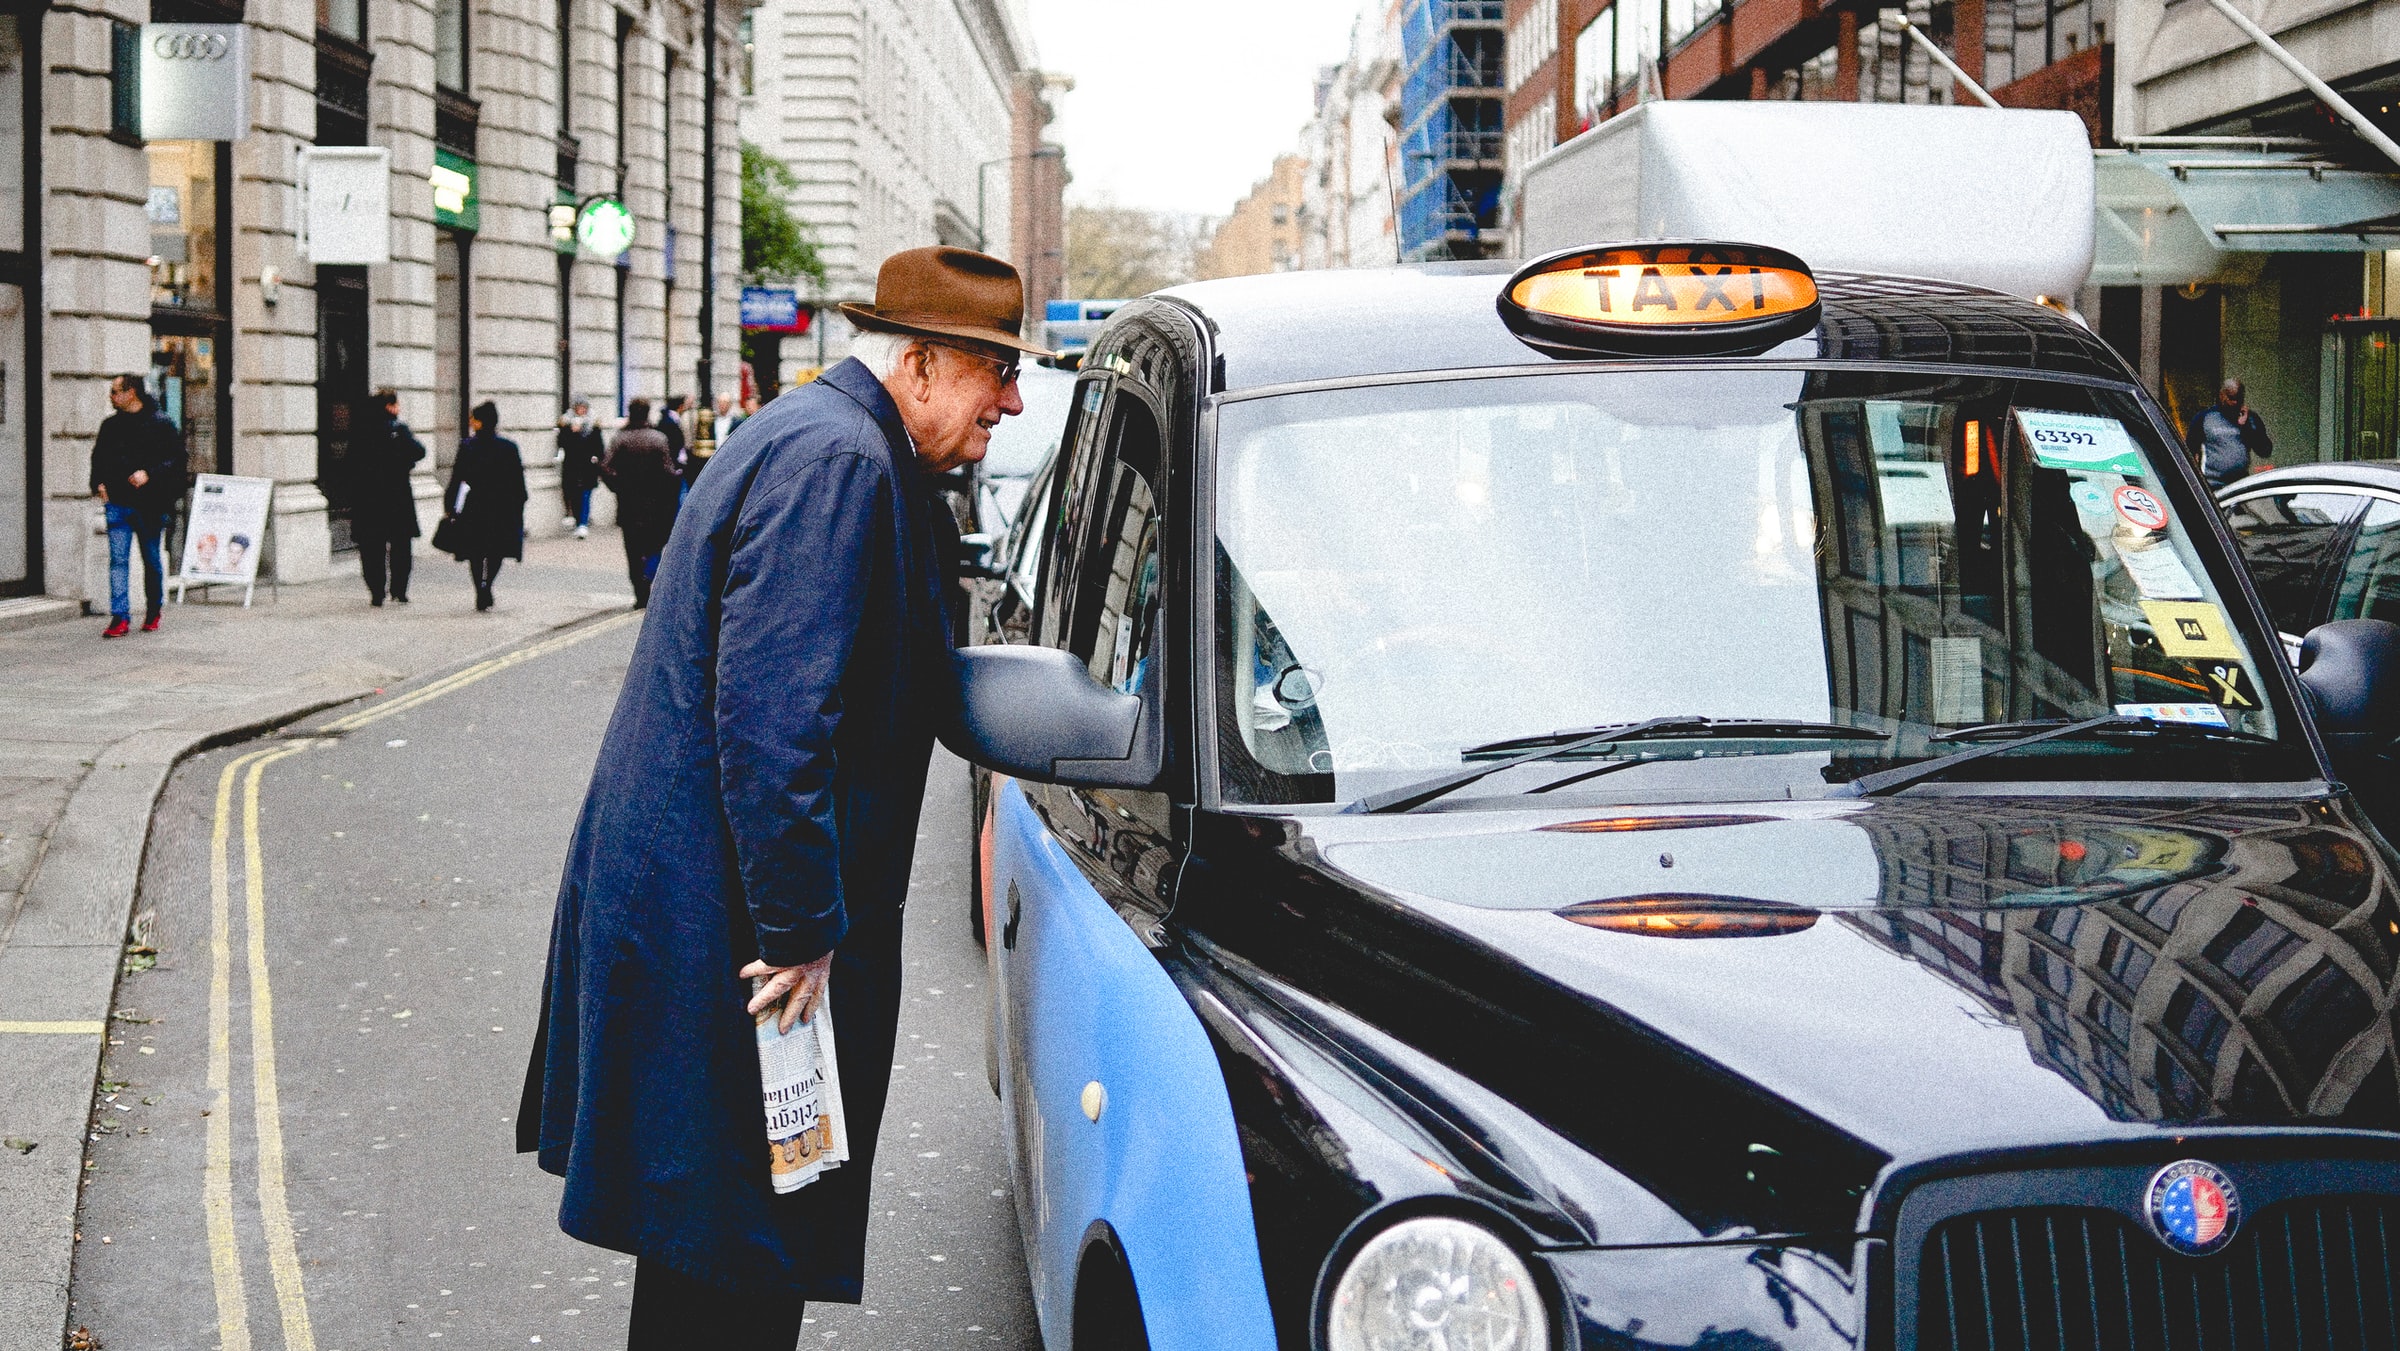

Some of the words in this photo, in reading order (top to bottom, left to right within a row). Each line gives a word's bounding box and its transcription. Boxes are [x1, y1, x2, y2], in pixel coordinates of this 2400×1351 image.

[1583, 266, 1766, 313] TAXI
[2034, 429, 2097, 446] 63392
[2183, 623, 2202, 636] AA
[791, 1076, 816, 1097] with
[765, 1098, 820, 1130] Telegr
[2163, 1165, 2216, 1186] LONDON
